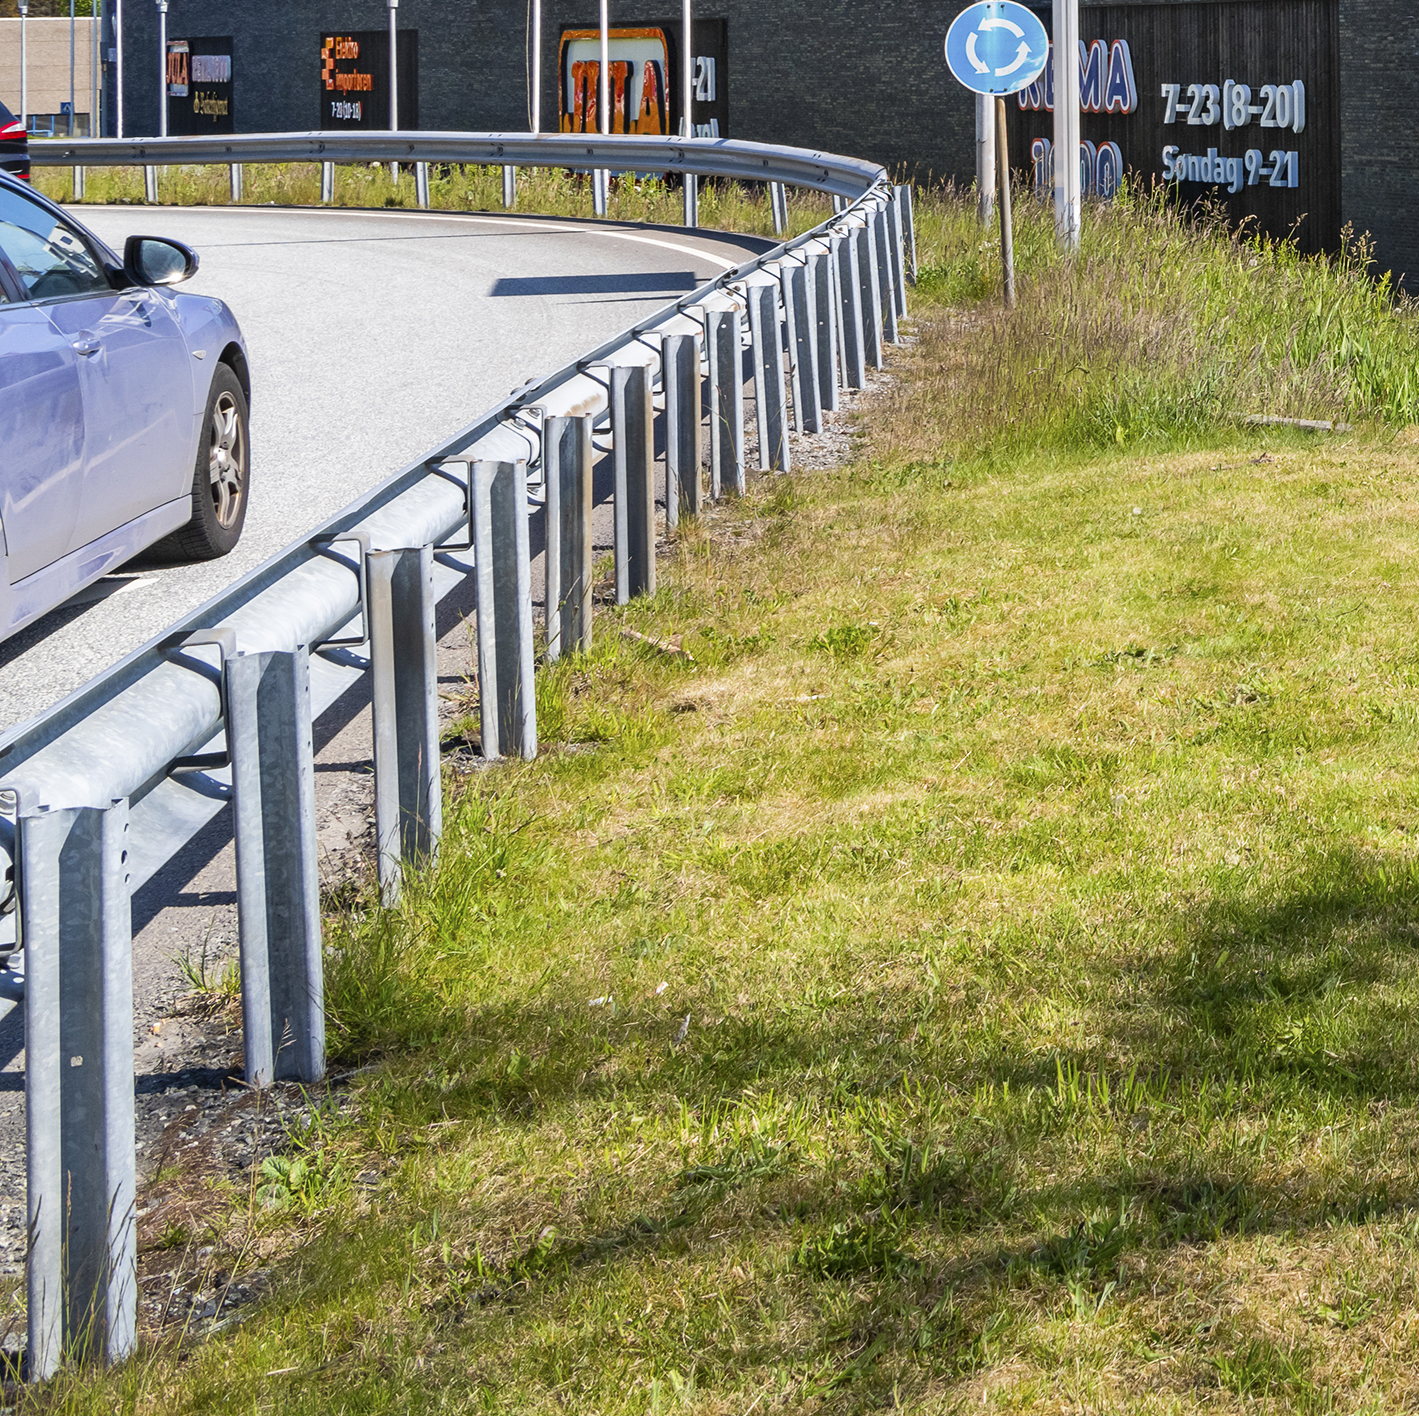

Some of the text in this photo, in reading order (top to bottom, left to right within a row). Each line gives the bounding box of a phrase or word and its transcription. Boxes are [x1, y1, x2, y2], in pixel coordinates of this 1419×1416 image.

[1161, 79, 1306, 134] 7-23 (8-20)
[1162, 145, 1299, 194] Søndag 9-21
